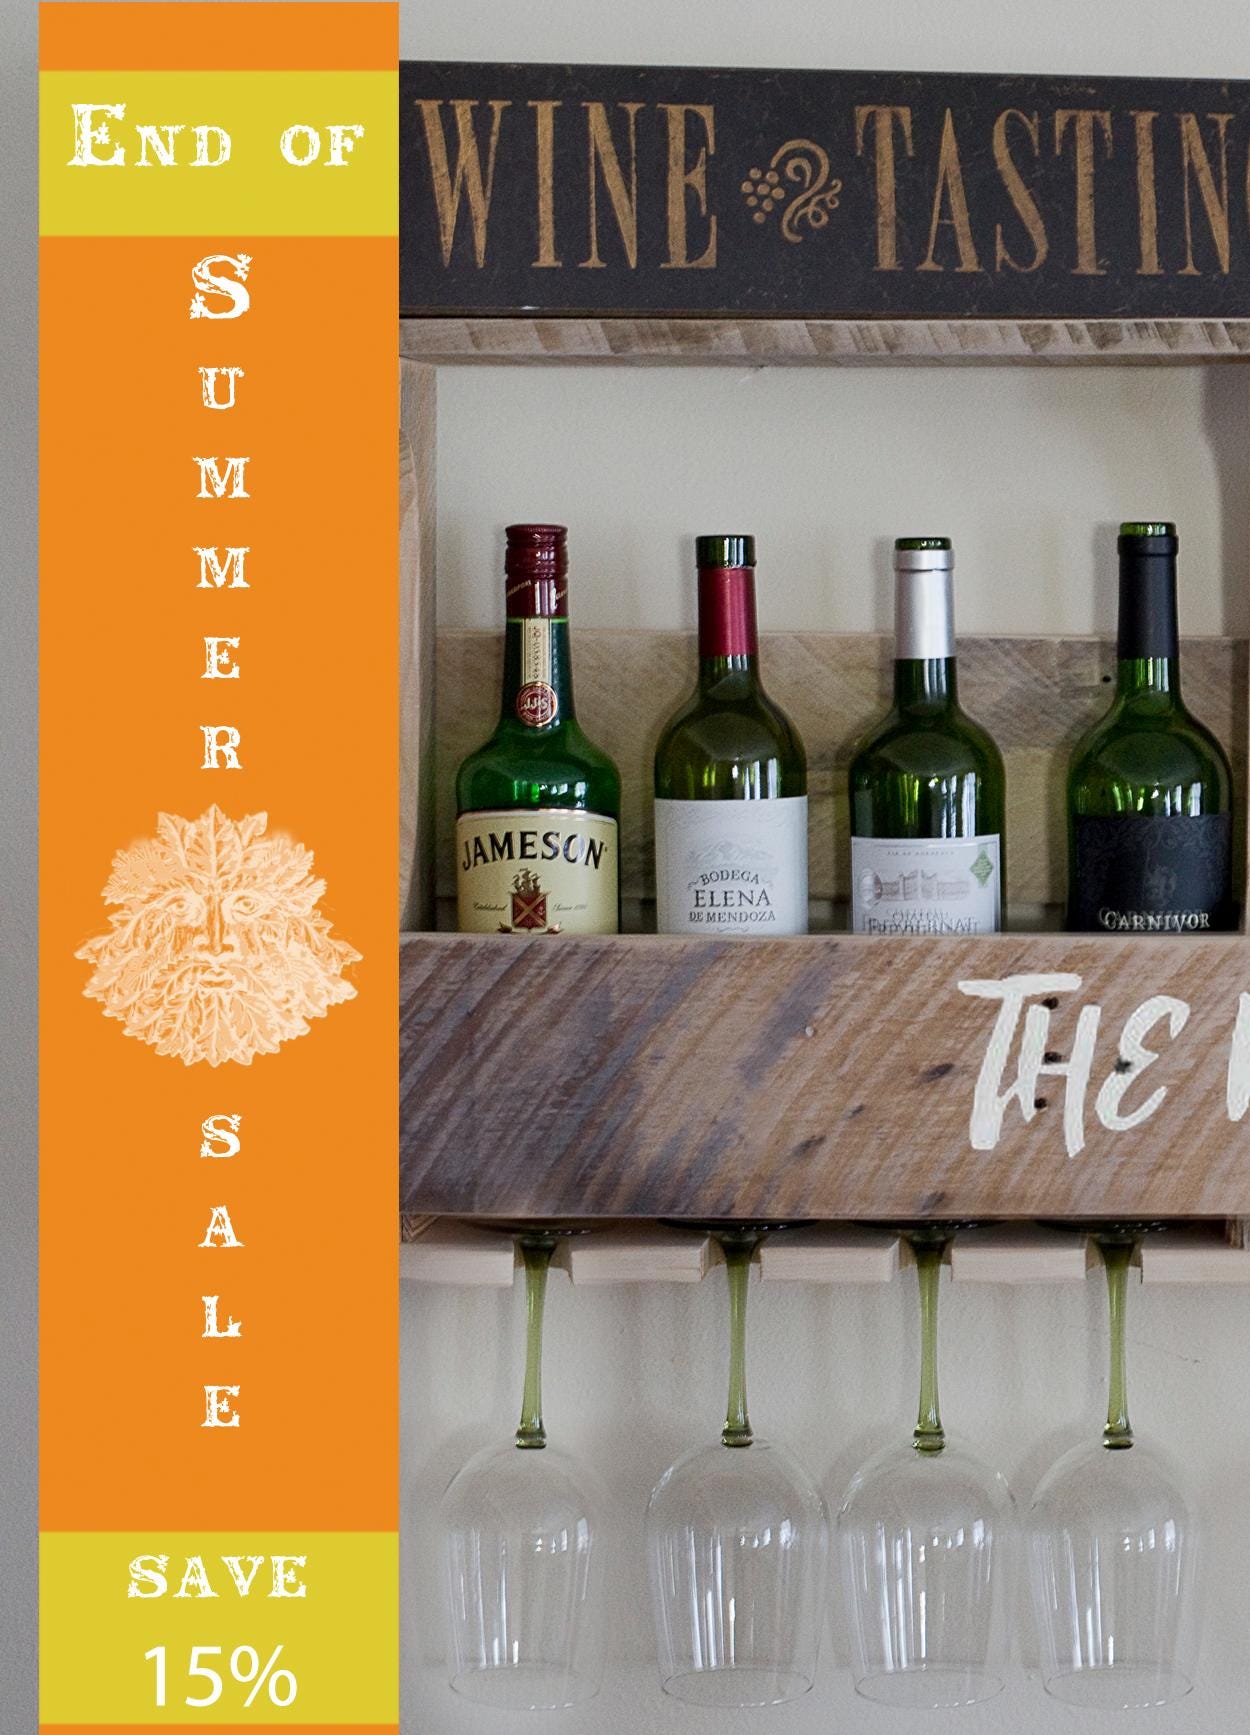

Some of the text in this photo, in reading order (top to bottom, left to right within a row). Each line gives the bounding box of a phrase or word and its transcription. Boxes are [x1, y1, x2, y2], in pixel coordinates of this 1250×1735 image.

[415, 98, 717, 269] WINE
[462, 830, 604, 871] JAMESON
[700, 869, 759, 886] BODEGA
[694, 888, 771, 908] ELENA
[689, 910, 776, 923] DE MENDOZA
[1104, 911, 1210, 932] CARNIVOR
[958, 973, 1191, 1157] THE
